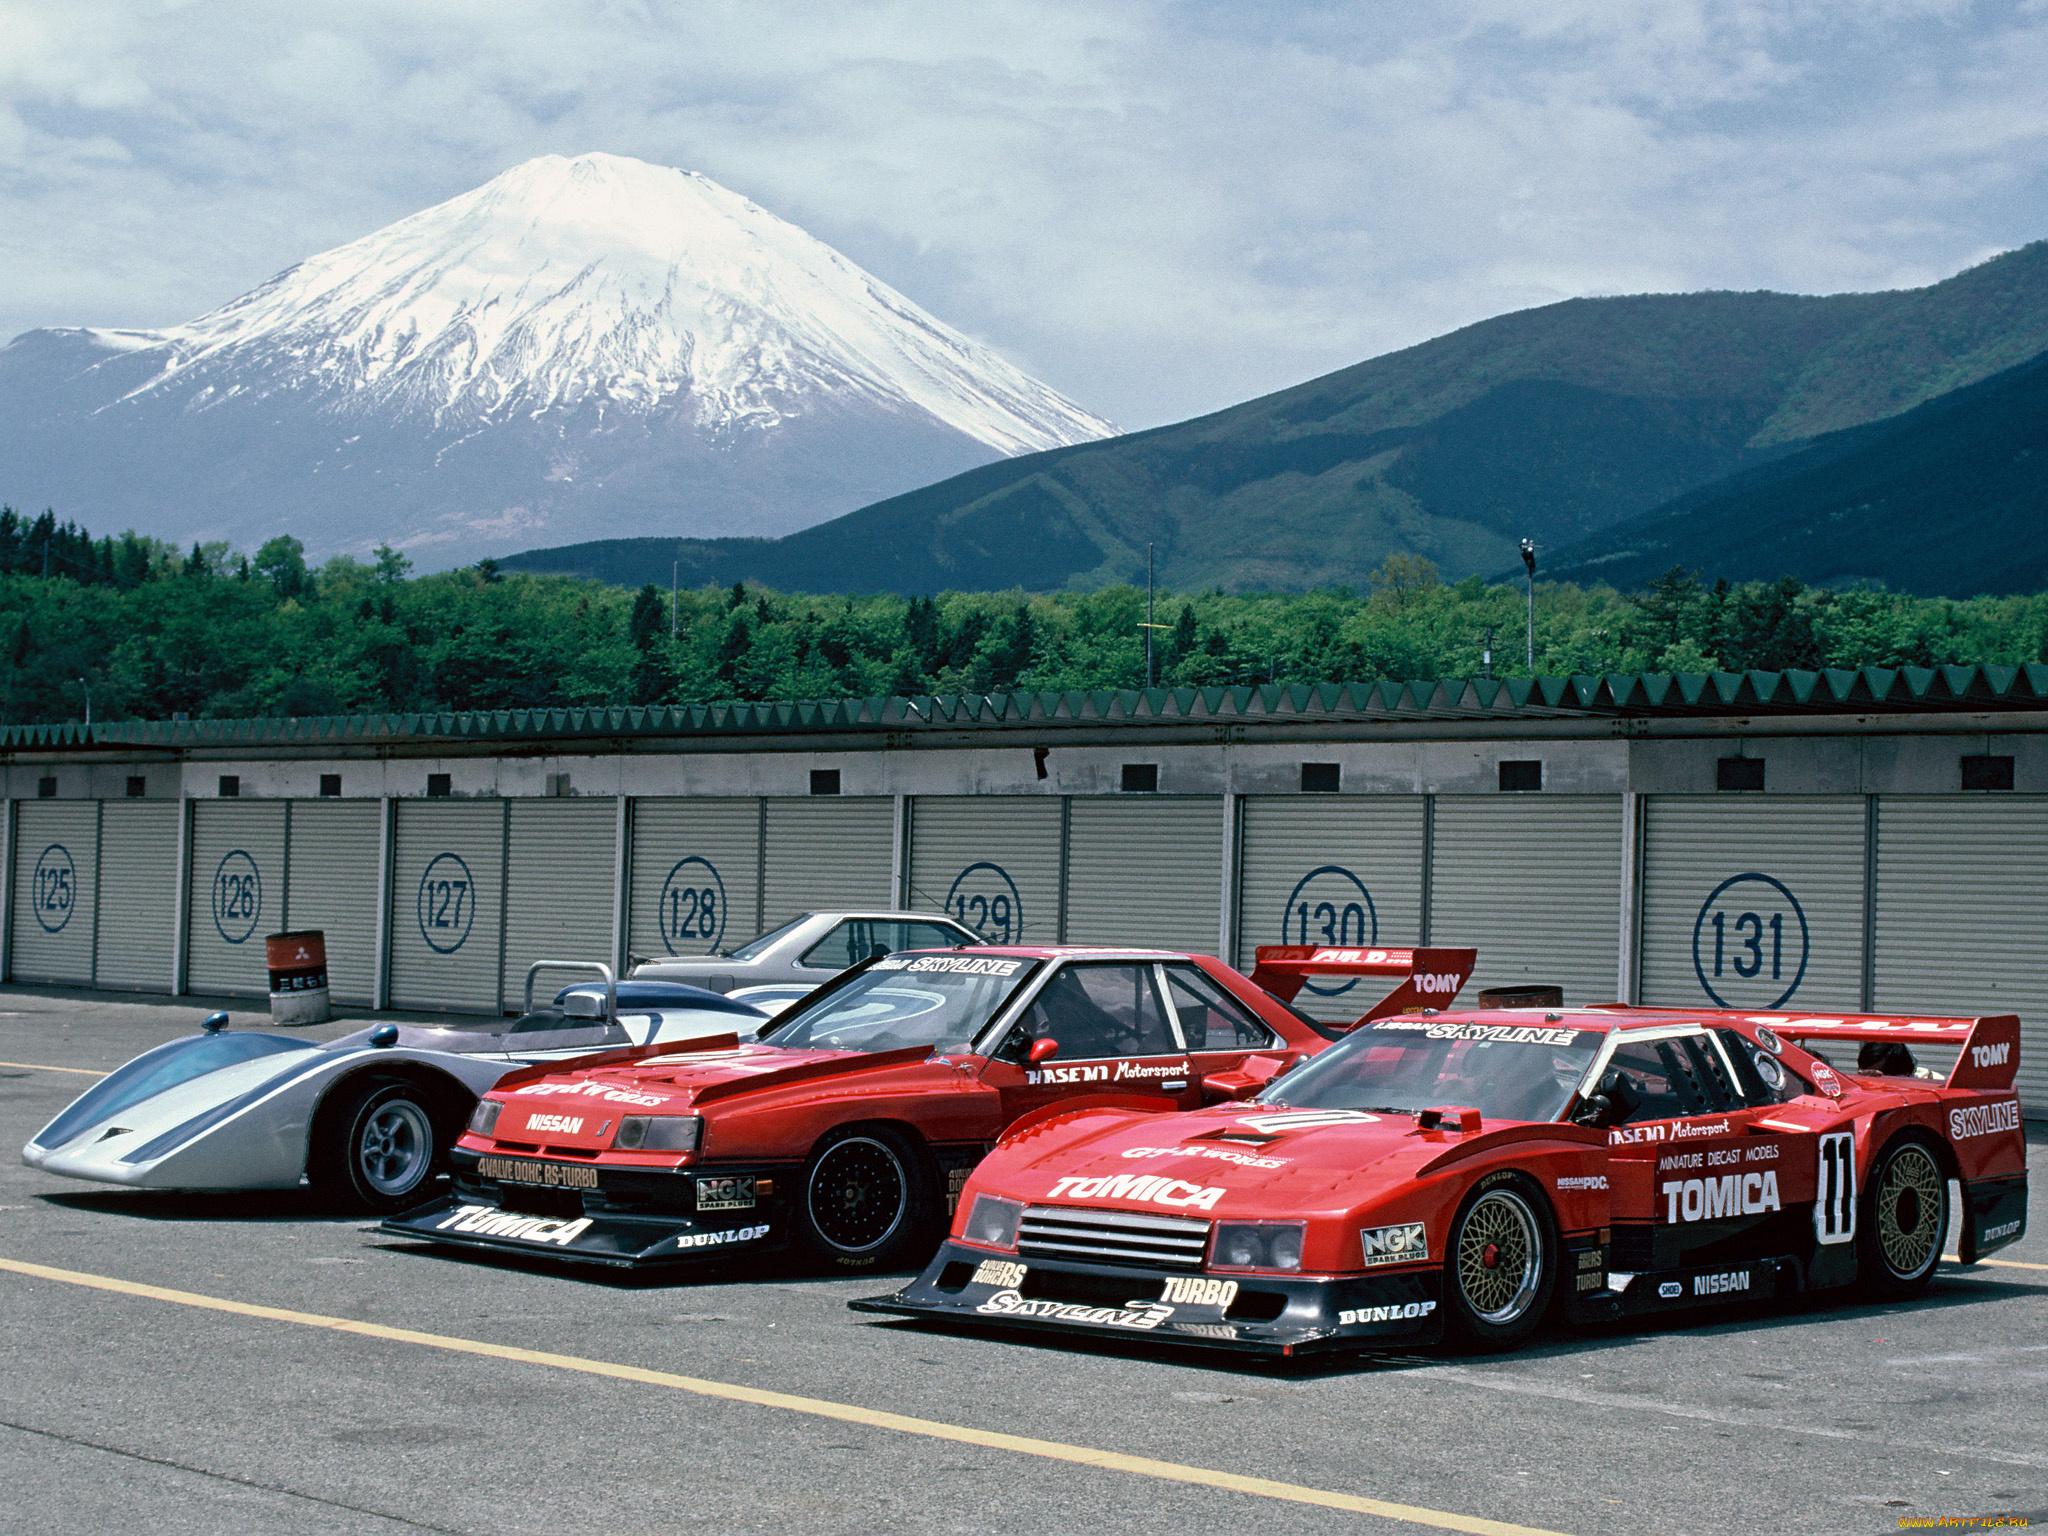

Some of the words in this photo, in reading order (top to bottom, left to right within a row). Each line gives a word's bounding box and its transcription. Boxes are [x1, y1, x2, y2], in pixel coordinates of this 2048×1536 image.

[40, 868, 70, 910] 125
[220, 874, 254, 918] 126
[428, 880, 467, 927] 127
[671, 887, 715, 938] 128
[1712, 911, 1782, 980] 131
[907, 957, 1022, 976] SKYLINE
[1413, 973, 1460, 993] TOMY
[1426, 1024, 1579, 1046] SKYLINE
[1971, 1042, 2010, 1068] TOMY
[1026, 1066, 1108, 1085] HASEMI
[1113, 1061, 1190, 1081] Motorsport
[1814, 1070, 1832, 1079] NGK
[526, 1114, 584, 1134] NISSAN
[1670, 1119, 1730, 1141] Motorsport
[1950, 1101, 2020, 1139] SKYLINE
[1202, 1149, 1287, 1168] WORKS
[1659, 1153, 1703, 1171] MINIATURE
[1707, 1149, 1741, 1167] DIECAST
[1745, 1145, 1779, 1164] MODELS
[477, 1157, 514, 1180] 4VALVE
[514, 1161, 542, 1183] DOHC
[544, 1165, 598, 1188] RS-TURBO
[1557, 1177, 1583, 1186] NISSAN
[700, 1178, 753, 1201] NGK
[1047, 1174, 1227, 1210] TOMICA
[1662, 1171, 1781, 1224] TOMICA
[1817, 1135, 1855, 1241] 11
[436, 1205, 594, 1246] TOMICA
[678, 1225, 770, 1247] DUNLOP
[1983, 1220, 2021, 1242] DUNLOP
[1364, 1225, 1425, 1255] NGK
[1367, 1254, 1397, 1265] SPARK
[1398, 1251, 1427, 1262] PLUGS
[971, 1269, 1001, 1284] DOHC
[996, 1262, 1028, 1288] RS
[1576, 1272, 1602, 1291] TURBO
[1694, 1271, 1750, 1296] NISSAN
[1160, 1277, 1239, 1306] TURBO
[1339, 1301, 1436, 1325] DUNLOP
